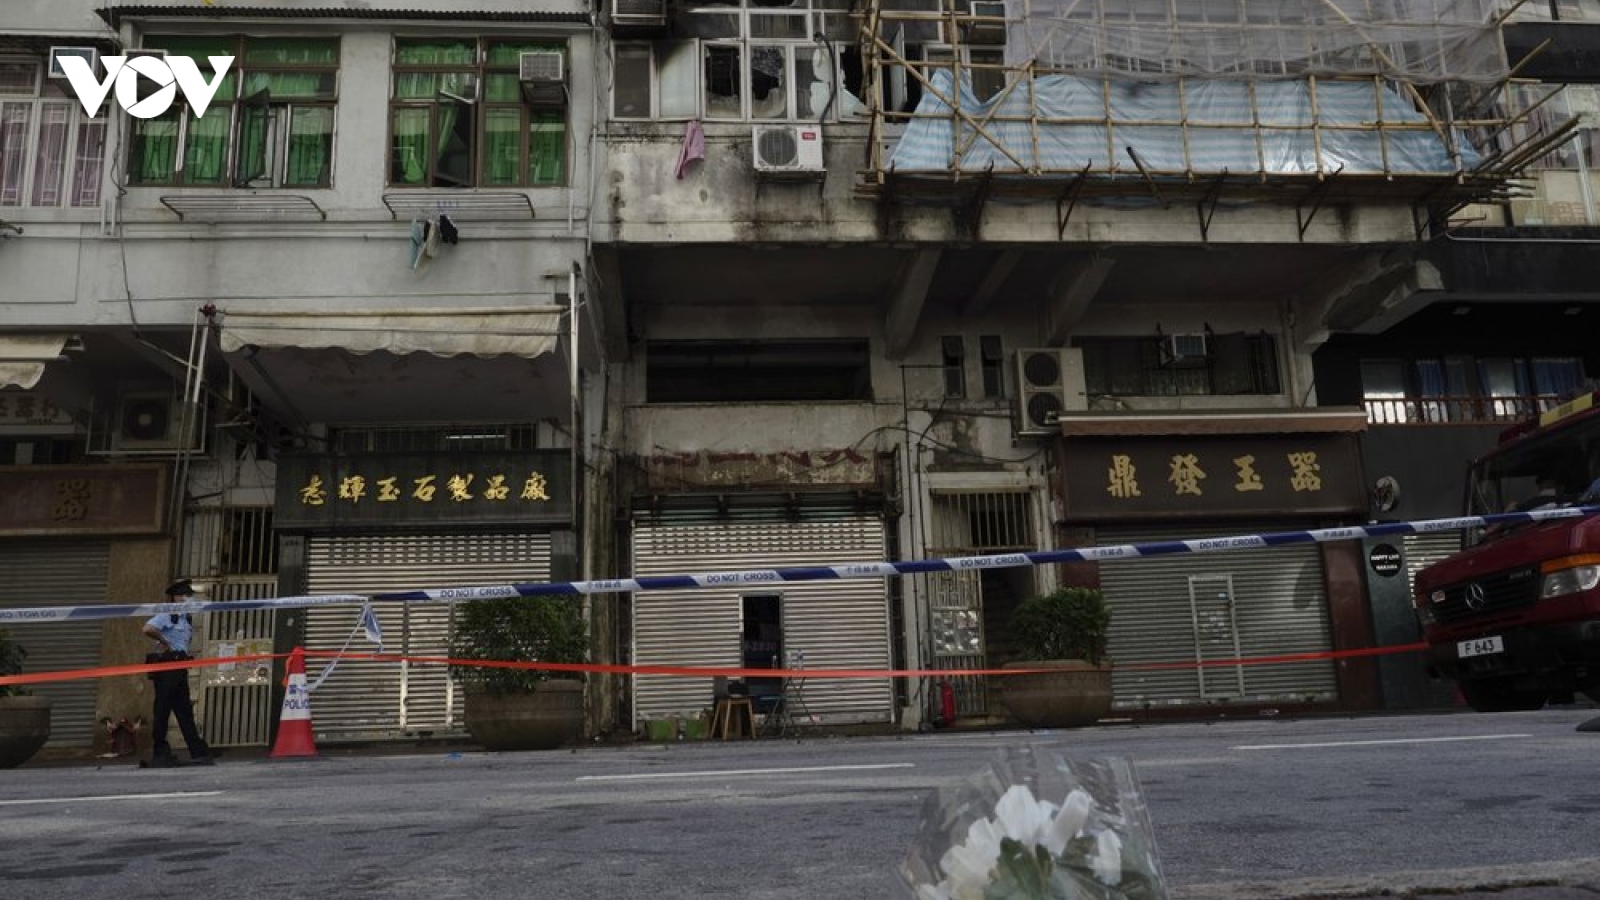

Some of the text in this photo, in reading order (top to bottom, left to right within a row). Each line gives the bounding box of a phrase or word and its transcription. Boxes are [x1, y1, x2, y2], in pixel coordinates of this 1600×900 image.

[1106, 452, 1321, 498] 鼎發玉器
[960, 556, 1025, 567] DO NOT CROSS
[706, 572, 774, 584] DO NOT CROSS
[440, 587, 511, 598] DO NOT CROSS
[1465, 639, 1494, 654] F 643
